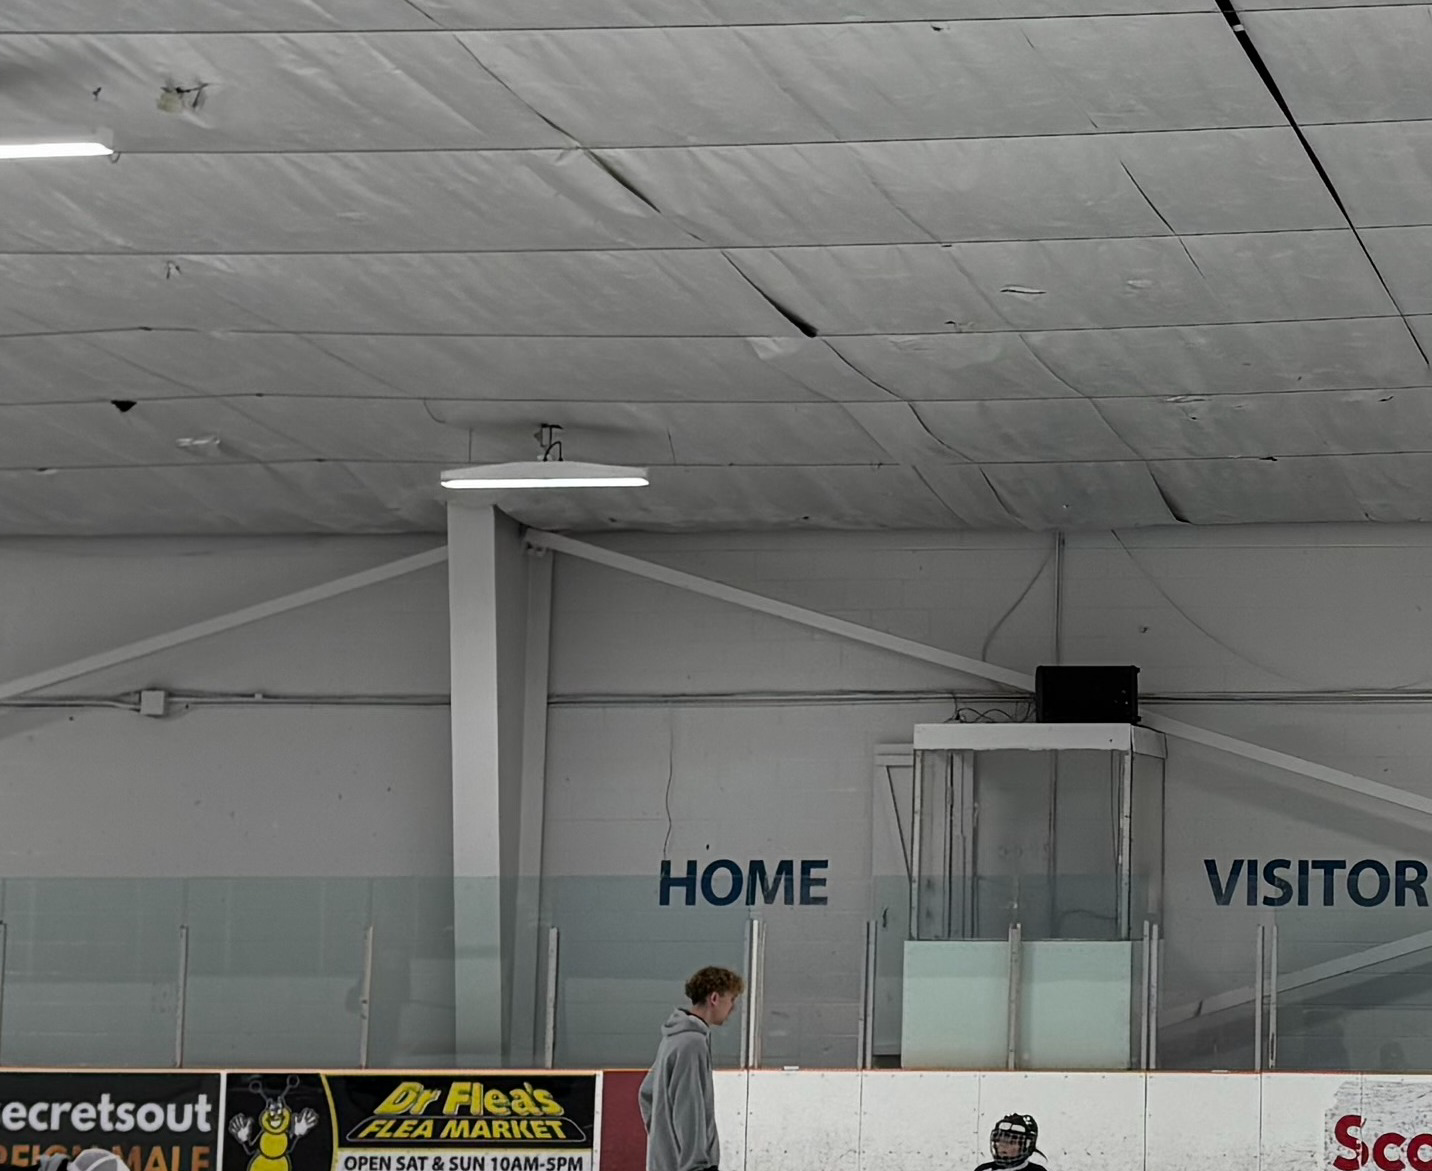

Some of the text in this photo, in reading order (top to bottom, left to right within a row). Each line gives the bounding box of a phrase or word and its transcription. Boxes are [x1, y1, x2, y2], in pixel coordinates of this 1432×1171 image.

[659, 858, 828, 906] HOME
[373, 1081, 565, 1116] Dr Flea's
[358, 1119, 567, 1139] FLEA MARKET
[343, 1156, 392, 1171] OPEN
[395, 1156, 429, 1171] SAT
[431, 1156, 445, 1171] &
[449, 1156, 486, 1171] SUN
